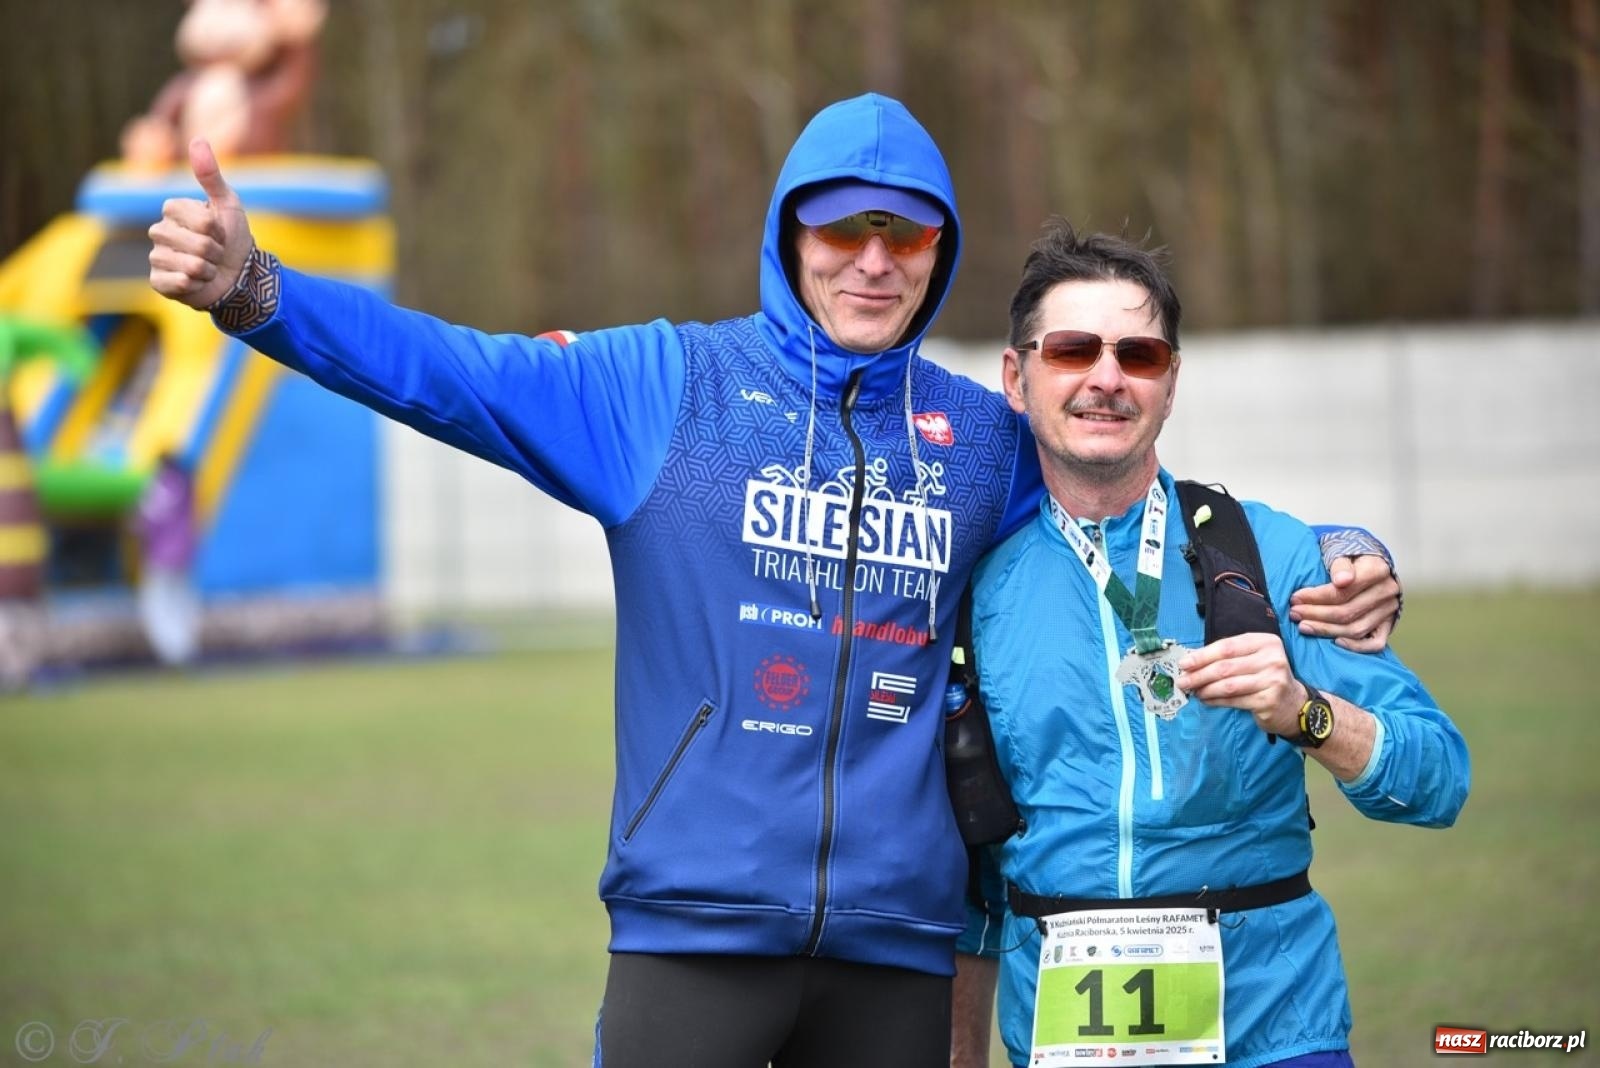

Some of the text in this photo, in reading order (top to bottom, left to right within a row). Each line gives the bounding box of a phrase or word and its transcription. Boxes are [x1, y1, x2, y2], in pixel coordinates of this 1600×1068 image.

[751, 490, 946, 565] SILESIAN
[752, 549, 884, 594] TRIATHLON
[741, 719, 813, 736] ERIGO
[1087, 915, 1134, 925] Półmaraton
[1136, 914, 1161, 925] Leśny
[1162, 914, 1204, 923] RAFAMET
[1127, 927, 1164, 935] kwietnia
[1165, 926, 1187, 934] 2025
[1074, 968, 1165, 1036] 11
